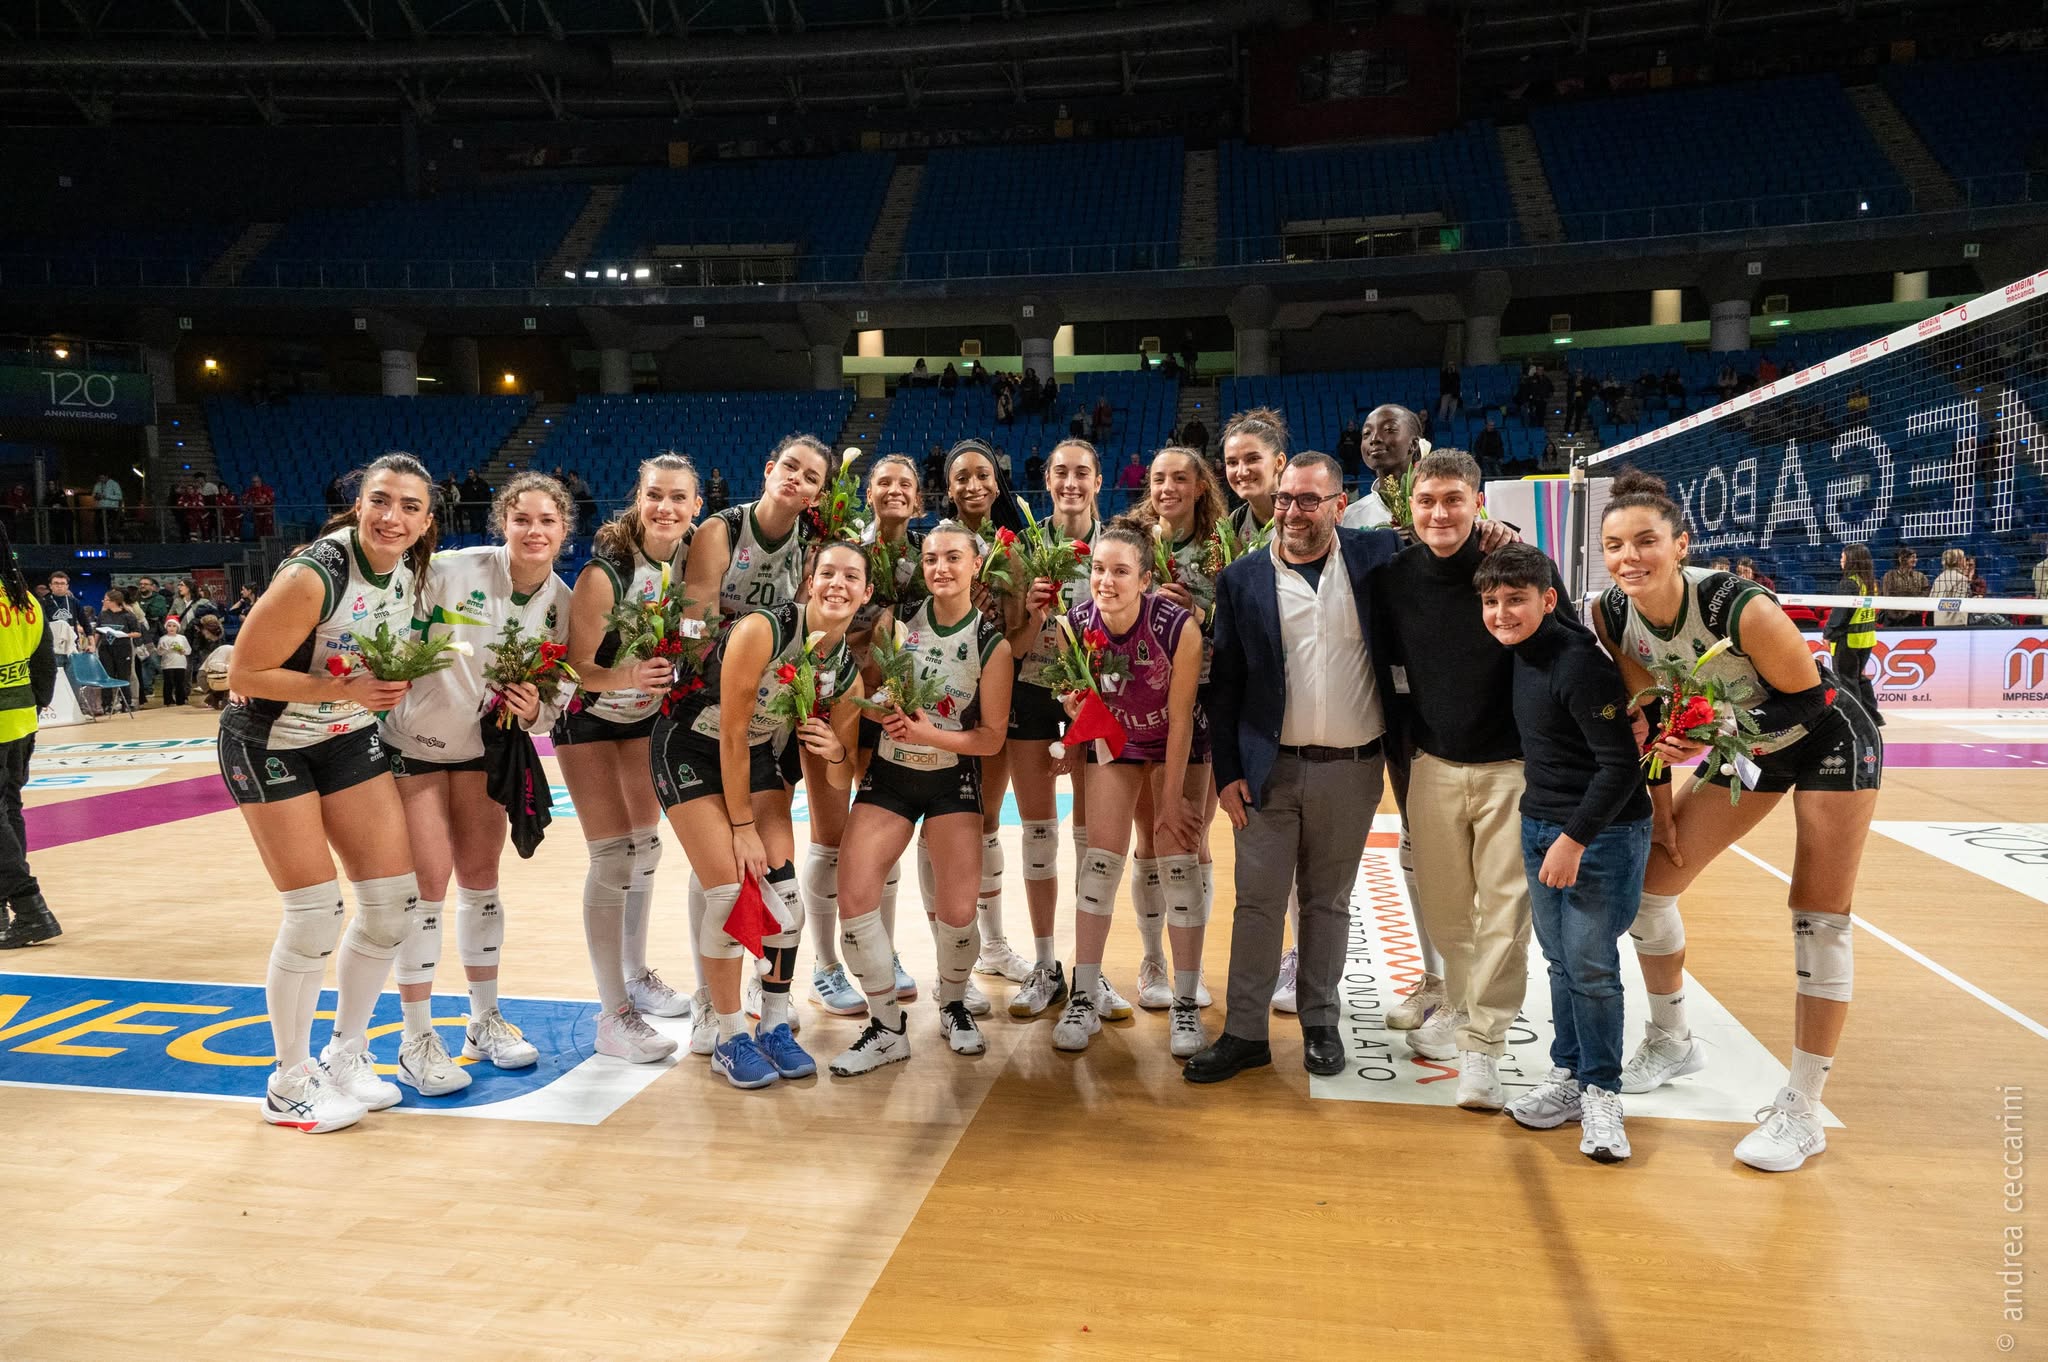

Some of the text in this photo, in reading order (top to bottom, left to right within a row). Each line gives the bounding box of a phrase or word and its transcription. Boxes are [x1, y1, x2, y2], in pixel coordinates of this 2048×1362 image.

[2005, 276, 2035, 295] GAMBINI
[2006, 287, 2036, 303] meccanica
[1917, 316, 1941, 331] GAMBINI
[44, 409, 118, 420] ANNIVERSARIO
[320, 542, 345, 565] MEGA
[745, 582, 775, 607] 20
[326, 641, 360, 652] BHS
[944, 684, 972, 699] Engico
[1912, 692, 1932, 702] s.r.l.
[894, 748, 937, 765] inpack
[1344, 904, 1397, 1081] CRTONE ONDULATO
